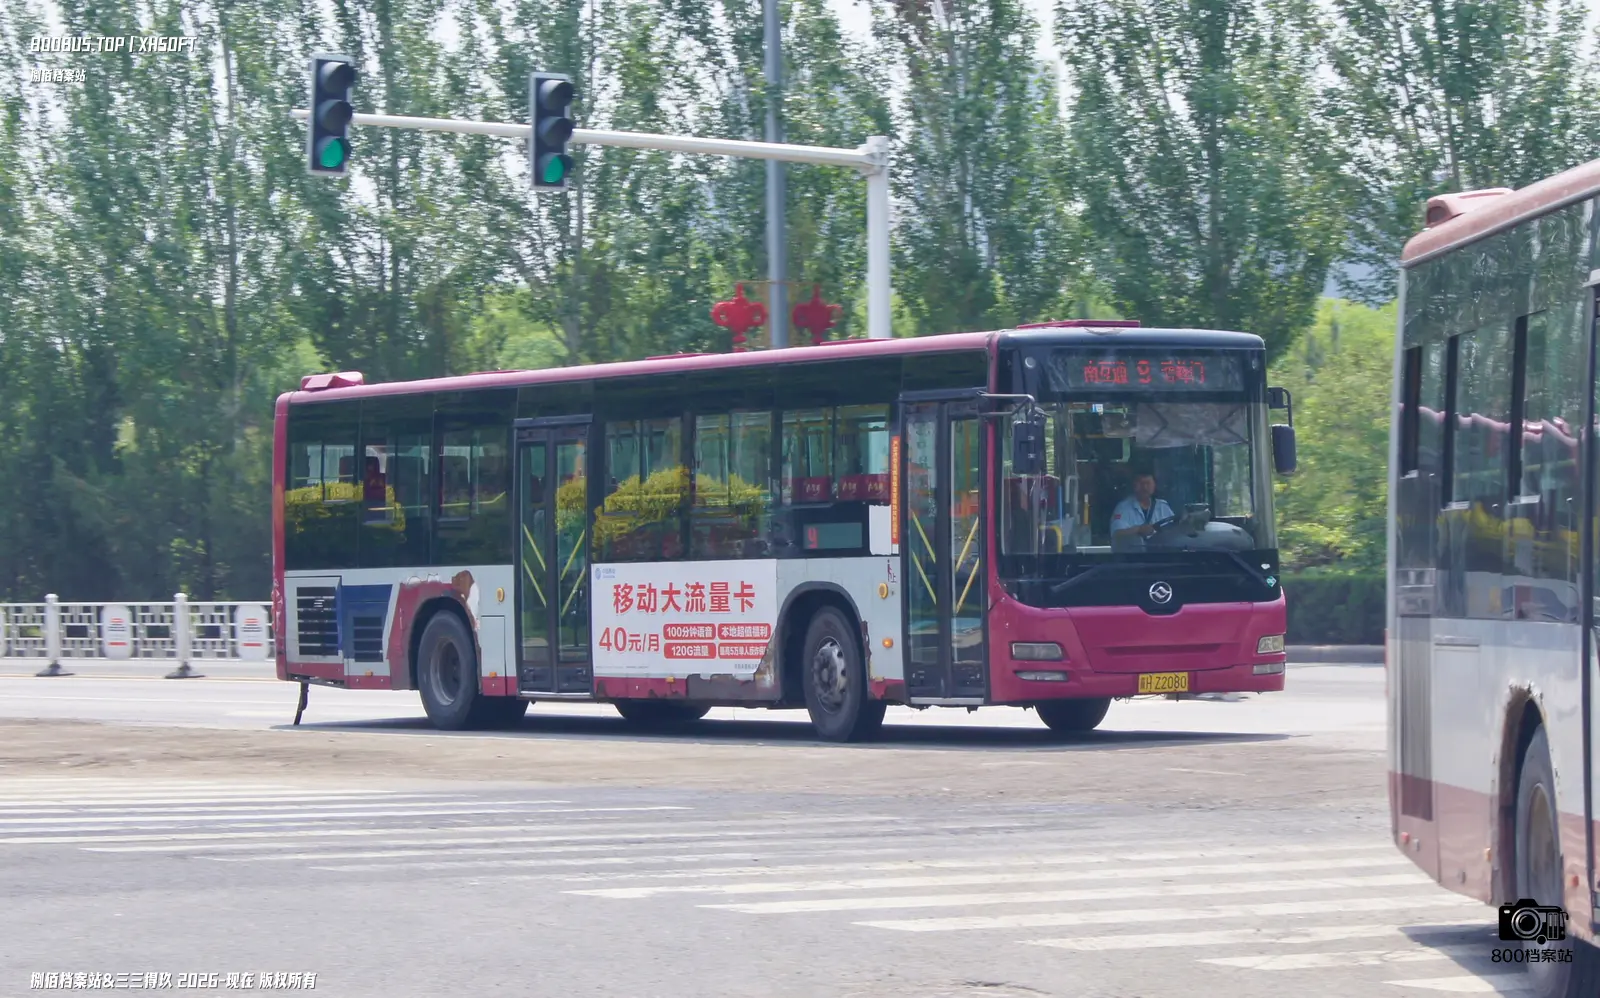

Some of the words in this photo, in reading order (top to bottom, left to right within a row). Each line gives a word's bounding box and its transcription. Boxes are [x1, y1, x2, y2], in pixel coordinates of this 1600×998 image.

[1137, 359, 1152, 384] 9
[613, 581, 755, 613] 移动大流量卡
[599, 627, 660, 653] 40元/月
[666, 626, 713, 638] 100分钟语音
[721, 626, 768, 638] 本地超值福利
[671, 645, 709, 656] 120G流量
